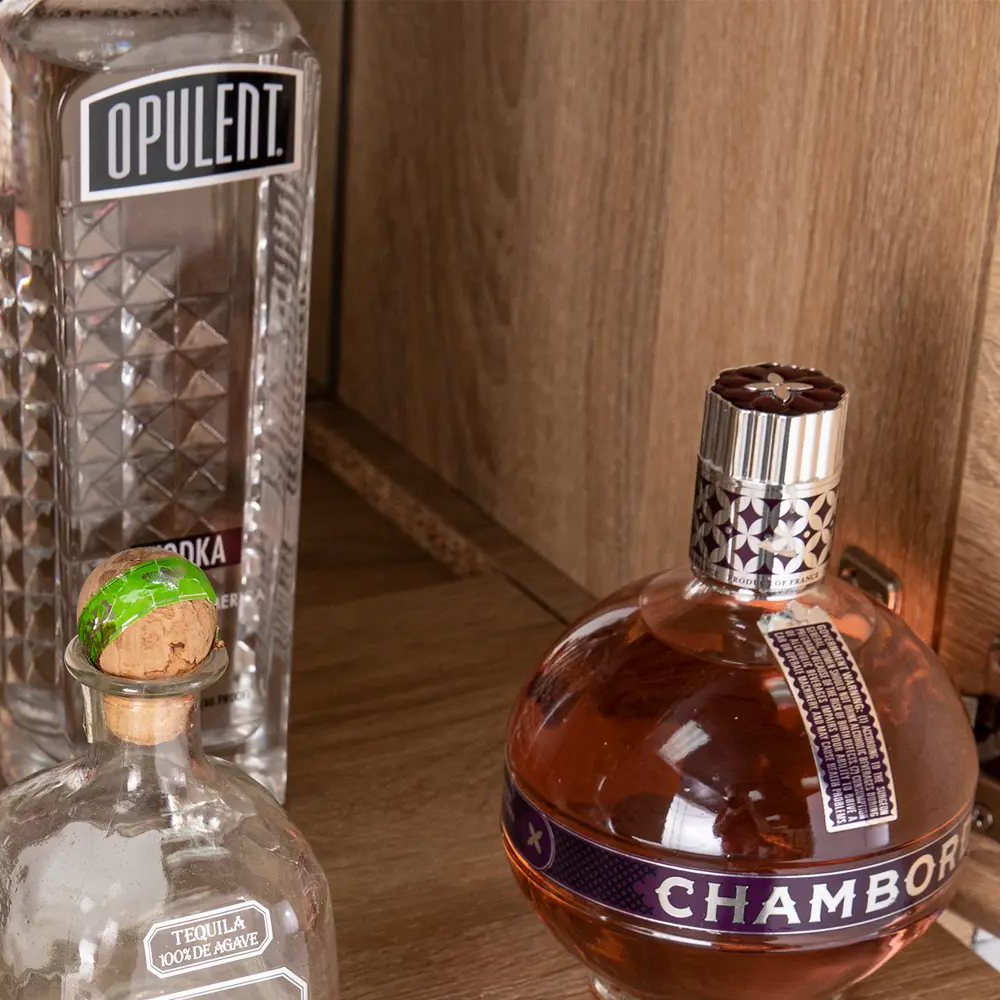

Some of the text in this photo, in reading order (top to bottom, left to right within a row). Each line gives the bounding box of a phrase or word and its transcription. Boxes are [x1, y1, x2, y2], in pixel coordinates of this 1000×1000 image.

[774, 631, 788, 644] CAR
[785, 629, 797, 638] OF
[795, 627, 818, 657] PREGNANCY
[781, 643, 792, 652] OR
[790, 638, 812, 669] ALCOHOLIC
[785, 651, 804, 675] OPERATE
[812, 655, 829, 679] BECAUSE
[820, 648, 836, 669] WOMEN
[806, 669, 828, 703] BEVERAGES
[823, 678, 833, 687] OF
[830, 669, 847, 691] SHOULD
[826, 687, 837, 698] THE
[839, 691, 851, 704] NOT
[830, 697, 842, 712] RISK
[844, 704, 858, 723] DRINK
[812, 711, 824, 725] AND
[817, 624, 888, 816] GOVERNMENT WARNING: (1) ACCORDING TO THE SURGEON
[821, 704, 837, 732] IMPAIRS
[835, 711, 845, 720] OF
[816, 726, 828, 741] MAY
[837, 719, 850, 739] BIRTH
[850, 722, 867, 757] ALCOHOLIC
[821, 741, 834, 762] CAUSE
[831, 734, 842, 752] YOUR
[827, 762, 841, 788] HEALTH
[835, 753, 850, 781] ABILITY
[858, 756, 874, 792] BEVERAGES
[842, 782, 852, 791] TO
[844, 793, 856, 814] DRIVE
[851, 775, 869, 820] CONSUMPTION
[866, 791, 879, 818] DURING
[171, 915, 246, 946] TEQUILA
[158, 932, 259, 967] 100% DE AGAVE
